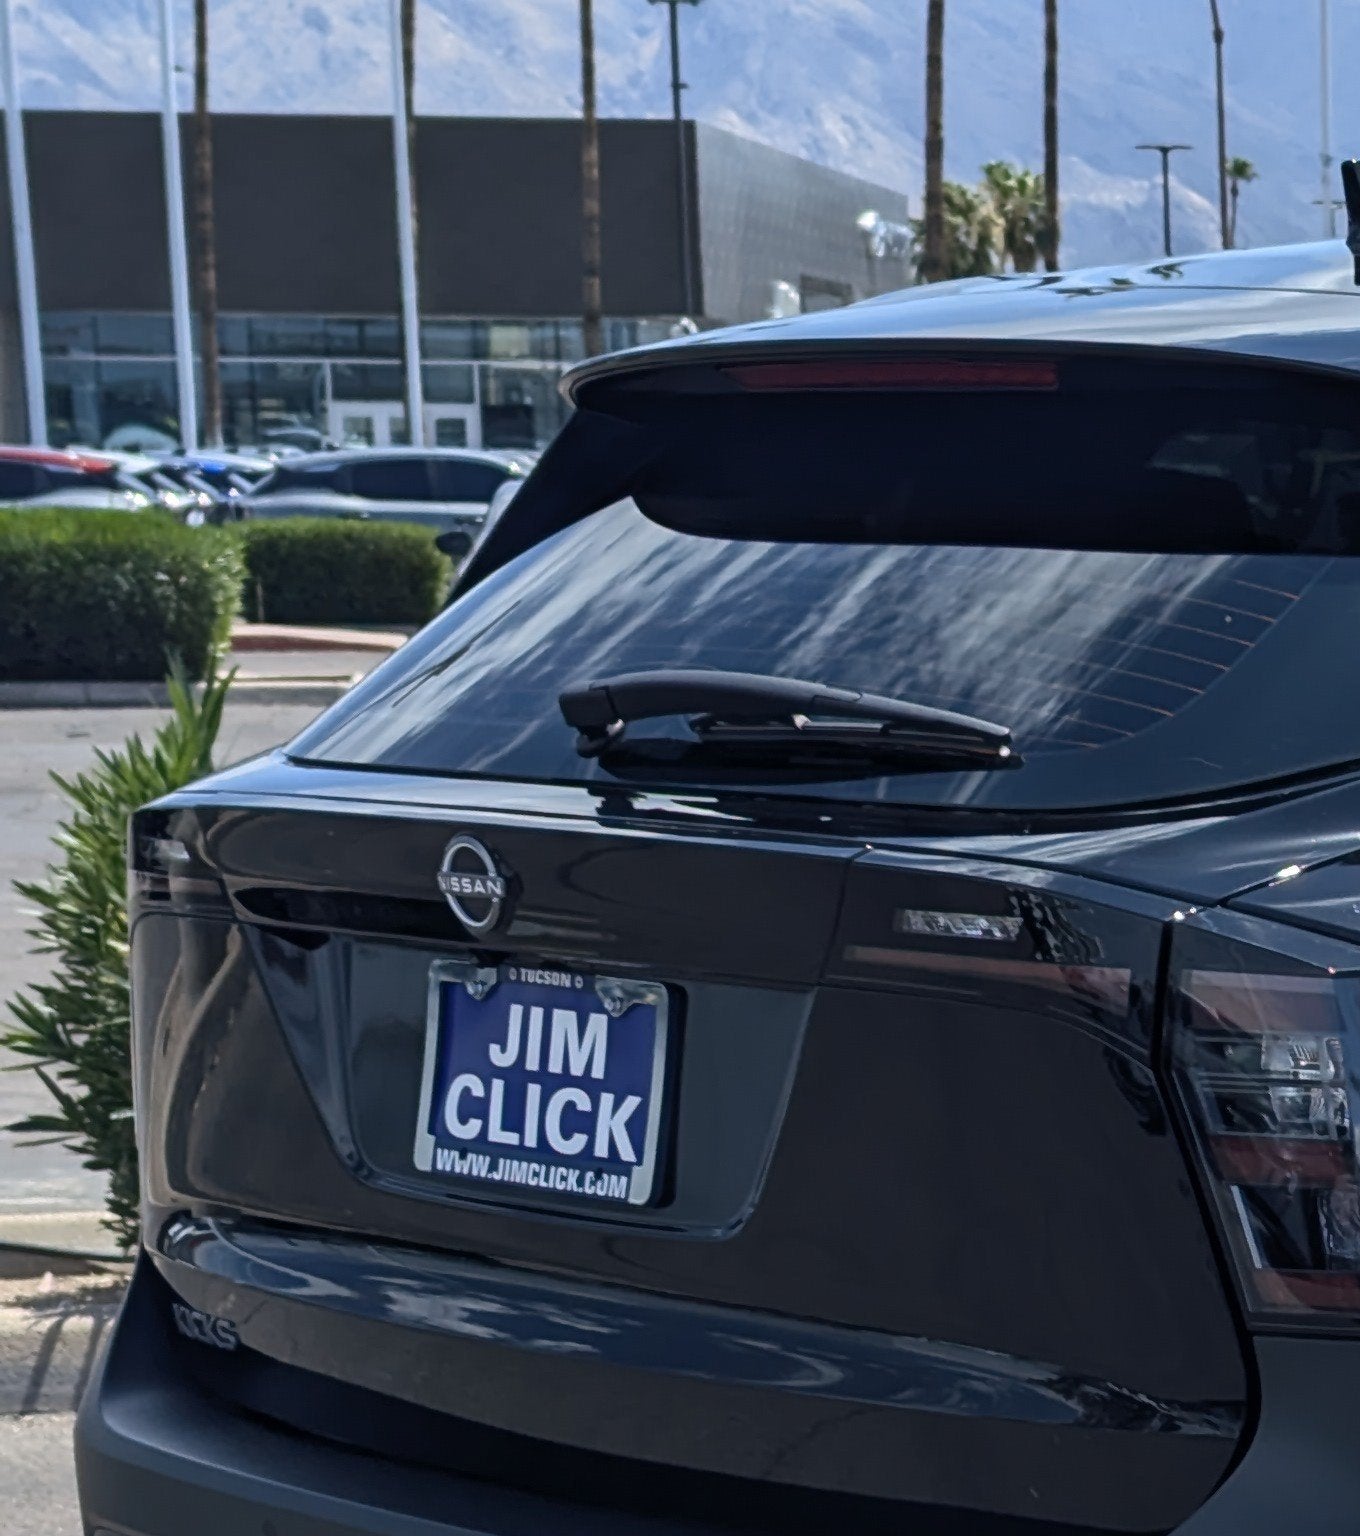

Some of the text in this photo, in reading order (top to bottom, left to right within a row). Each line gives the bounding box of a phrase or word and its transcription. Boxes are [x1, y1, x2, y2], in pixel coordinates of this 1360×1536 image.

[437, 875, 502, 895] NISSAN
[520, 967, 572, 988] TUCSON
[489, 1003, 609, 1079] JIM
[445, 1074, 643, 1162] CLICK
[436, 1148, 629, 1199] WWW.JIMCLICK.COM
